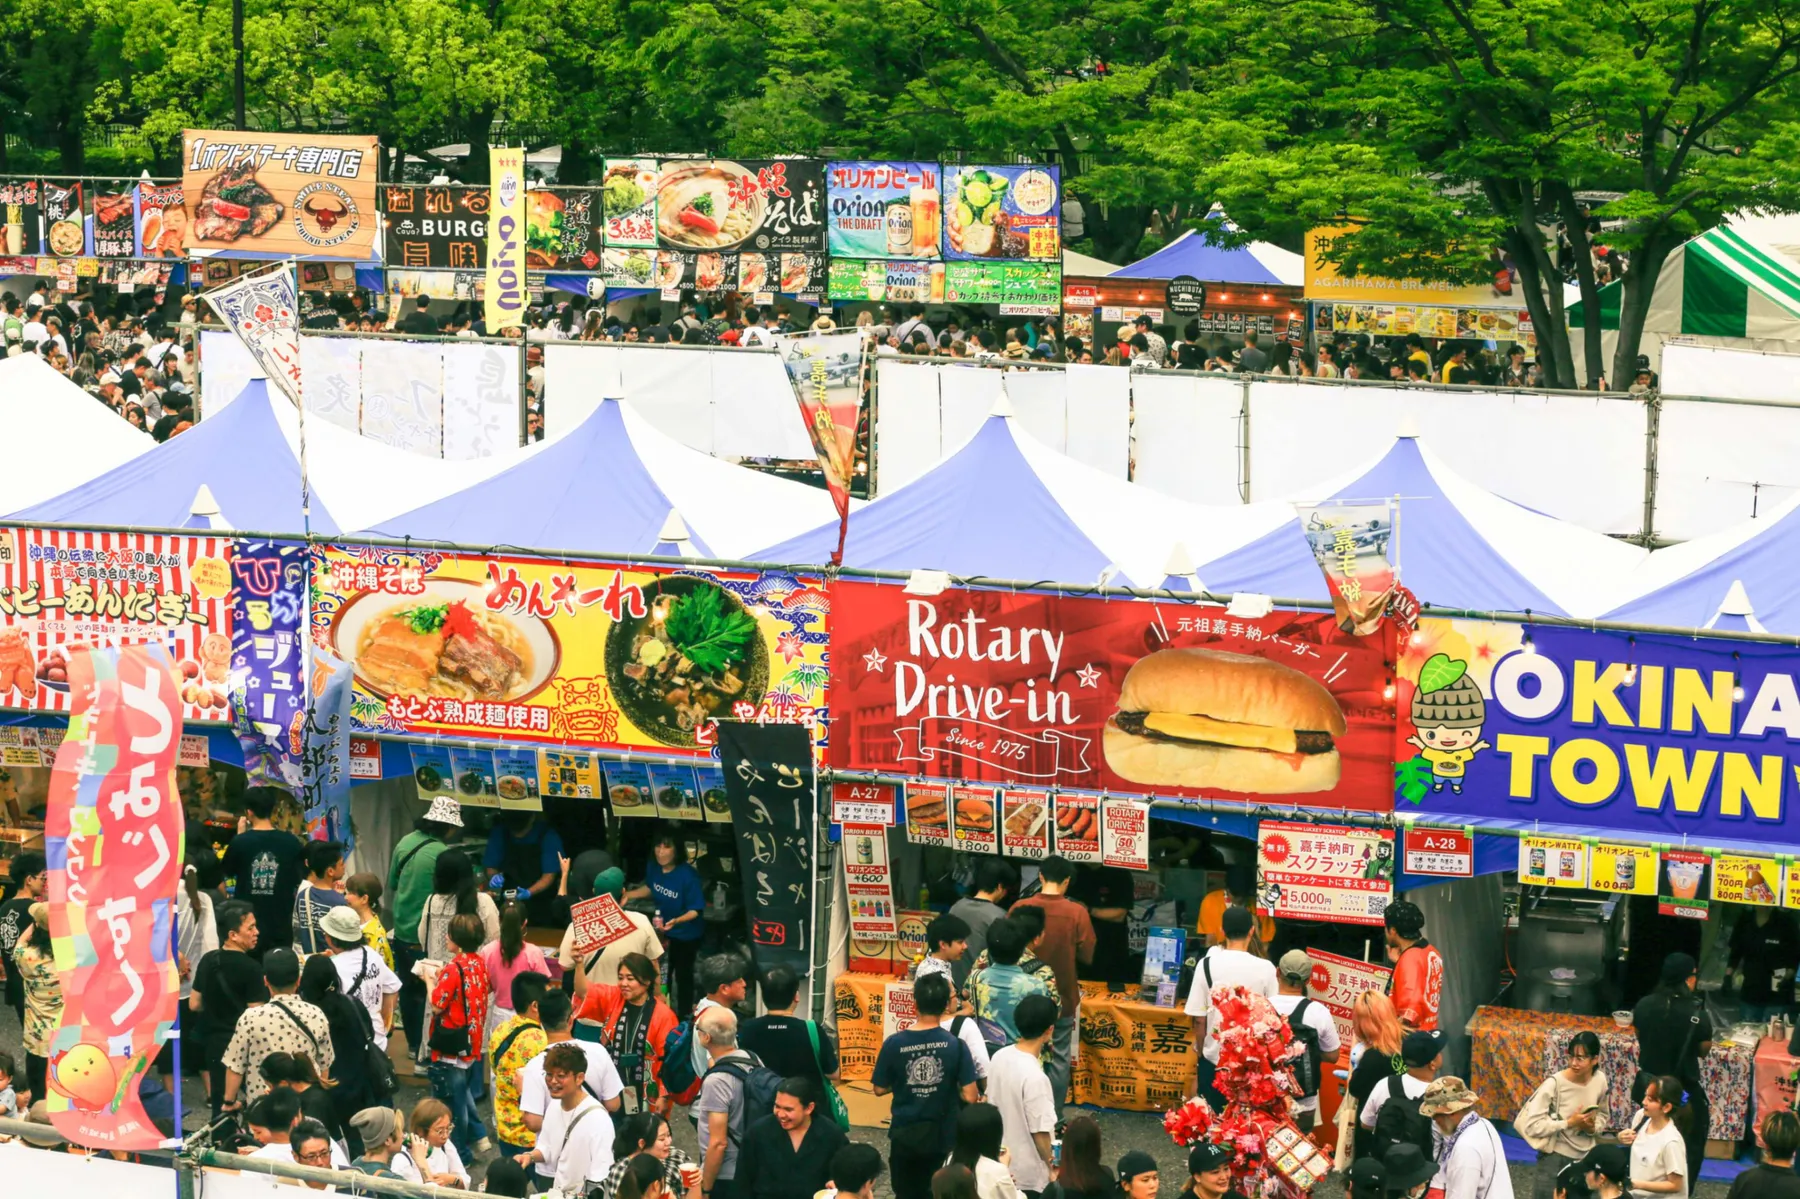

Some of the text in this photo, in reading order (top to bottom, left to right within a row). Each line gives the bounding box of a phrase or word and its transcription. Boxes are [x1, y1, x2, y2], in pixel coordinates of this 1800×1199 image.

[833, 168, 935, 190] オリオンビール
[294, 181, 358, 215] SMILE STEAK
[764, 191, 822, 235] そば
[833, 195, 885, 217] Orion
[422, 219, 488, 237] BURG
[837, 217, 882, 231] THE DRAFT
[324, 219, 359, 247] STEAK
[887, 274, 917, 286] Orion
[1313, 276, 1397, 290] AGARIHAMA
[50, 565, 160, 583] 本気で向き合いました
[331, 563, 425, 593] 沖縄そば
[906, 599, 1066, 682] Rotary
[1176, 617, 1321, 659] 元祖嘉手納バーガー
[894, 661, 1081, 725] Drive-in
[388, 696, 549, 730] もとぶ熟成麺使用
[350, 742, 367, 754] -26
[945, 727, 1031, 762] Since 1975
[1496, 732, 1784, 820] TOWN
[850, 786, 881, 800] A-27
[1109, 808, 1142, 818] ROTARY
[844, 828, 883, 837] ORION BEER
[1108, 820, 1144, 832] DRIVE-IN
[965, 833, 994, 842] チーズバーガー
[1424, 836, 1457, 850] A-28
[1524, 838, 1583, 850] オリオンWATTA
[957, 839, 990, 853] ¥800
[1266, 843, 1286, 853] 無料
[1300, 839, 1355, 856] 嘉手納町
[1596, 846, 1651, 858] オリオンビール
[848, 865, 886, 875] オリオンビール
[1287, 854, 1367, 875] スクラッチ
[854, 874, 884, 884] ¥600
[1266, 872, 1387, 890] 簡単なアンケートに答えて参加
[1595, 879, 1629, 891] 600円
[1717, 878, 1743, 888] 700円
[1290, 890, 1332, 905] 5,000円
[1717, 890, 1743, 901] 800円
[575, 911, 632, 948] 最後尾
[1355, 964, 1374, 973] SCRATCH
[1338, 972, 1382, 990] 嘉手納町
[890, 1003, 916, 1014] DRIVE-
[1131, 1020, 1147, 1053] 沖縄県
[1150, 1023, 1193, 1054] 嘉
[900, 1041, 949, 1053] AWAMORI RYUKYU
